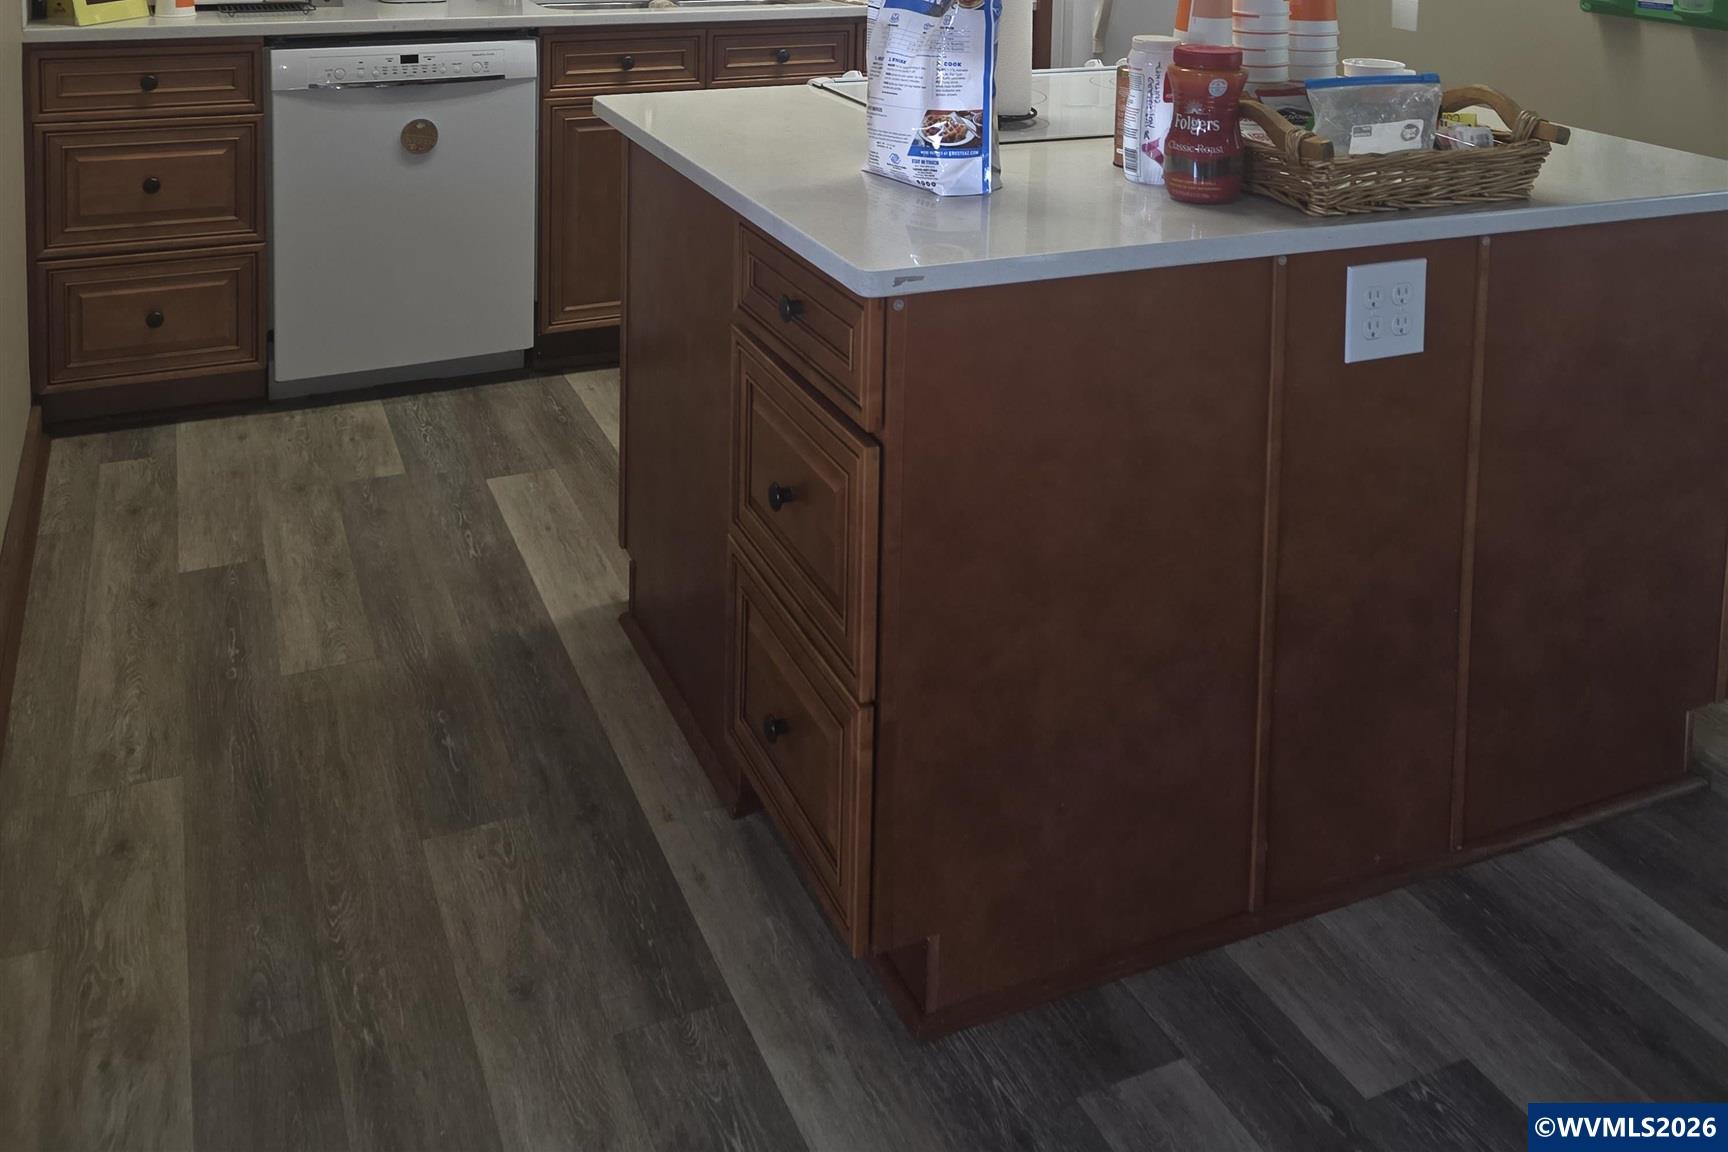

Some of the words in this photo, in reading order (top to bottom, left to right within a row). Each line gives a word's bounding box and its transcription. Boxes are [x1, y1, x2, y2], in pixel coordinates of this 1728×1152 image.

[1175, 113, 1220, 136] Folgers
[1168, 140, 1195, 153] Classic
[1197, 144, 1224, 154] Roast
